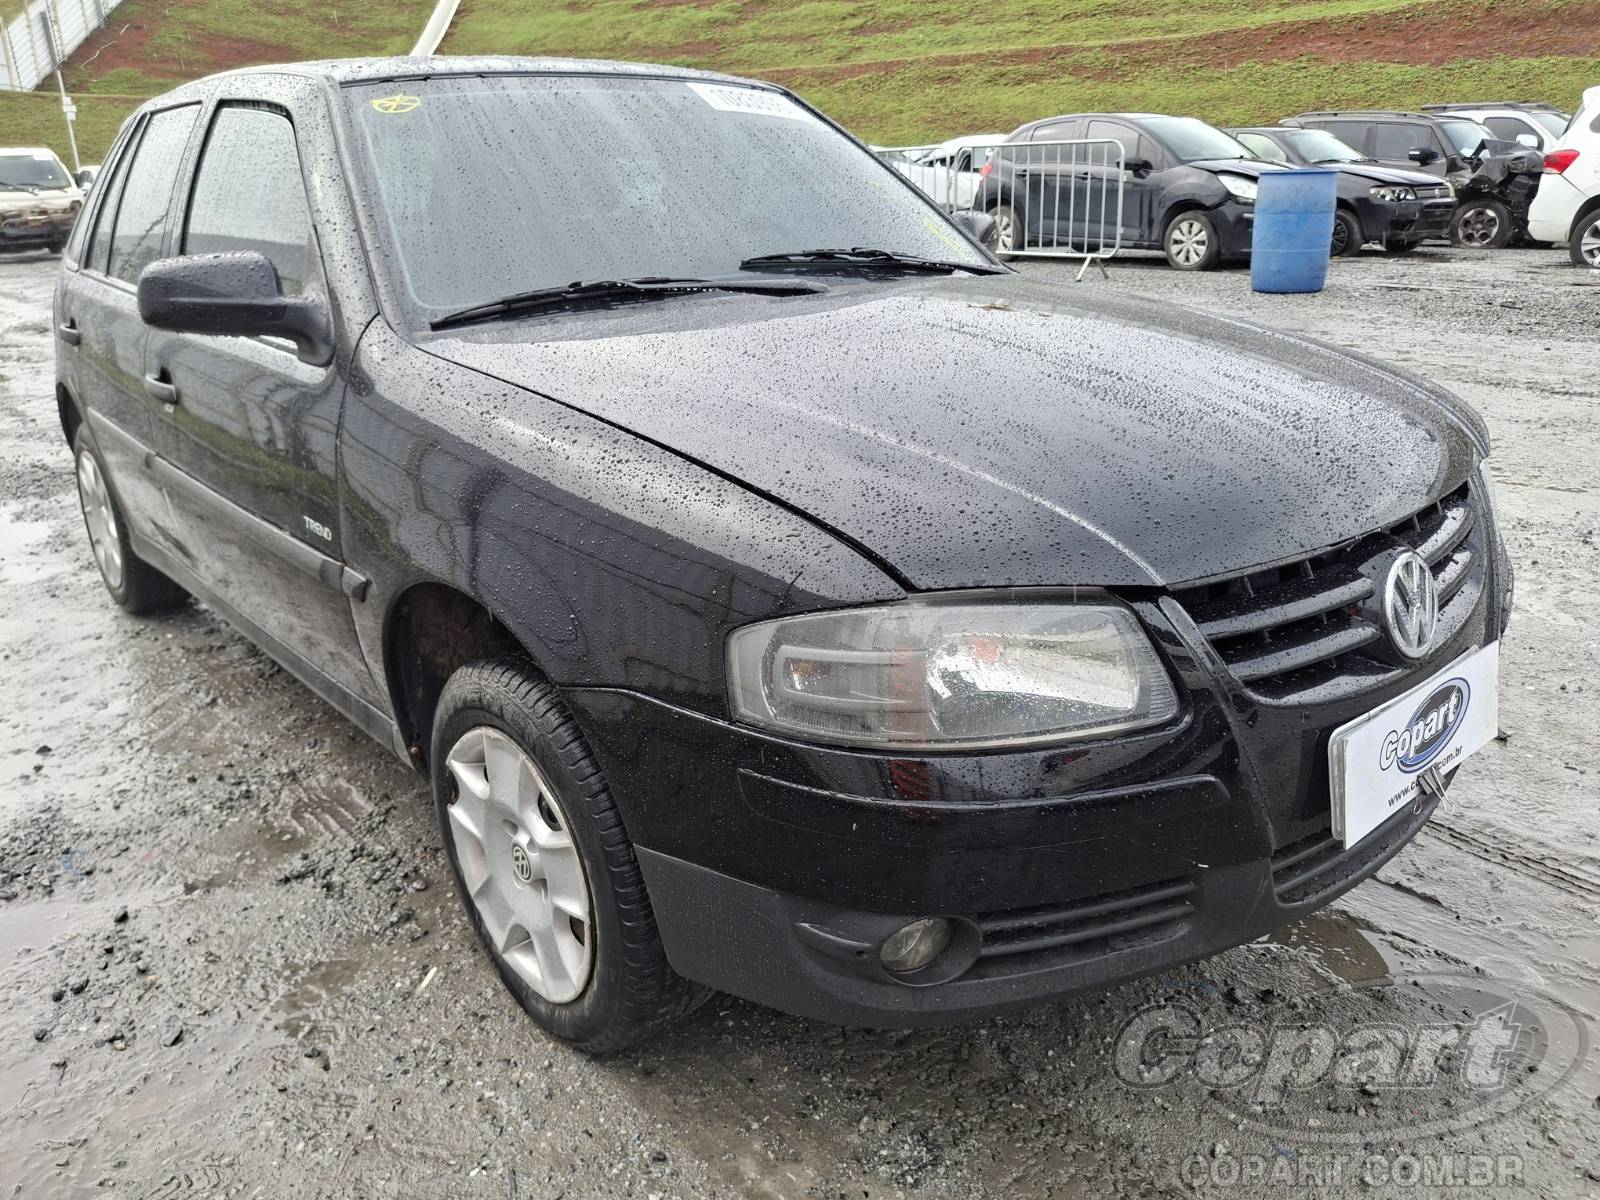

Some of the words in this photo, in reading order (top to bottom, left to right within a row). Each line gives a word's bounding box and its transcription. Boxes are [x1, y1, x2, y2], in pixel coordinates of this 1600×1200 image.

[302, 515, 332, 541] TREND
[1379, 686, 1461, 771] Copart
[1388, 745, 1463, 807] www.cocom.br
